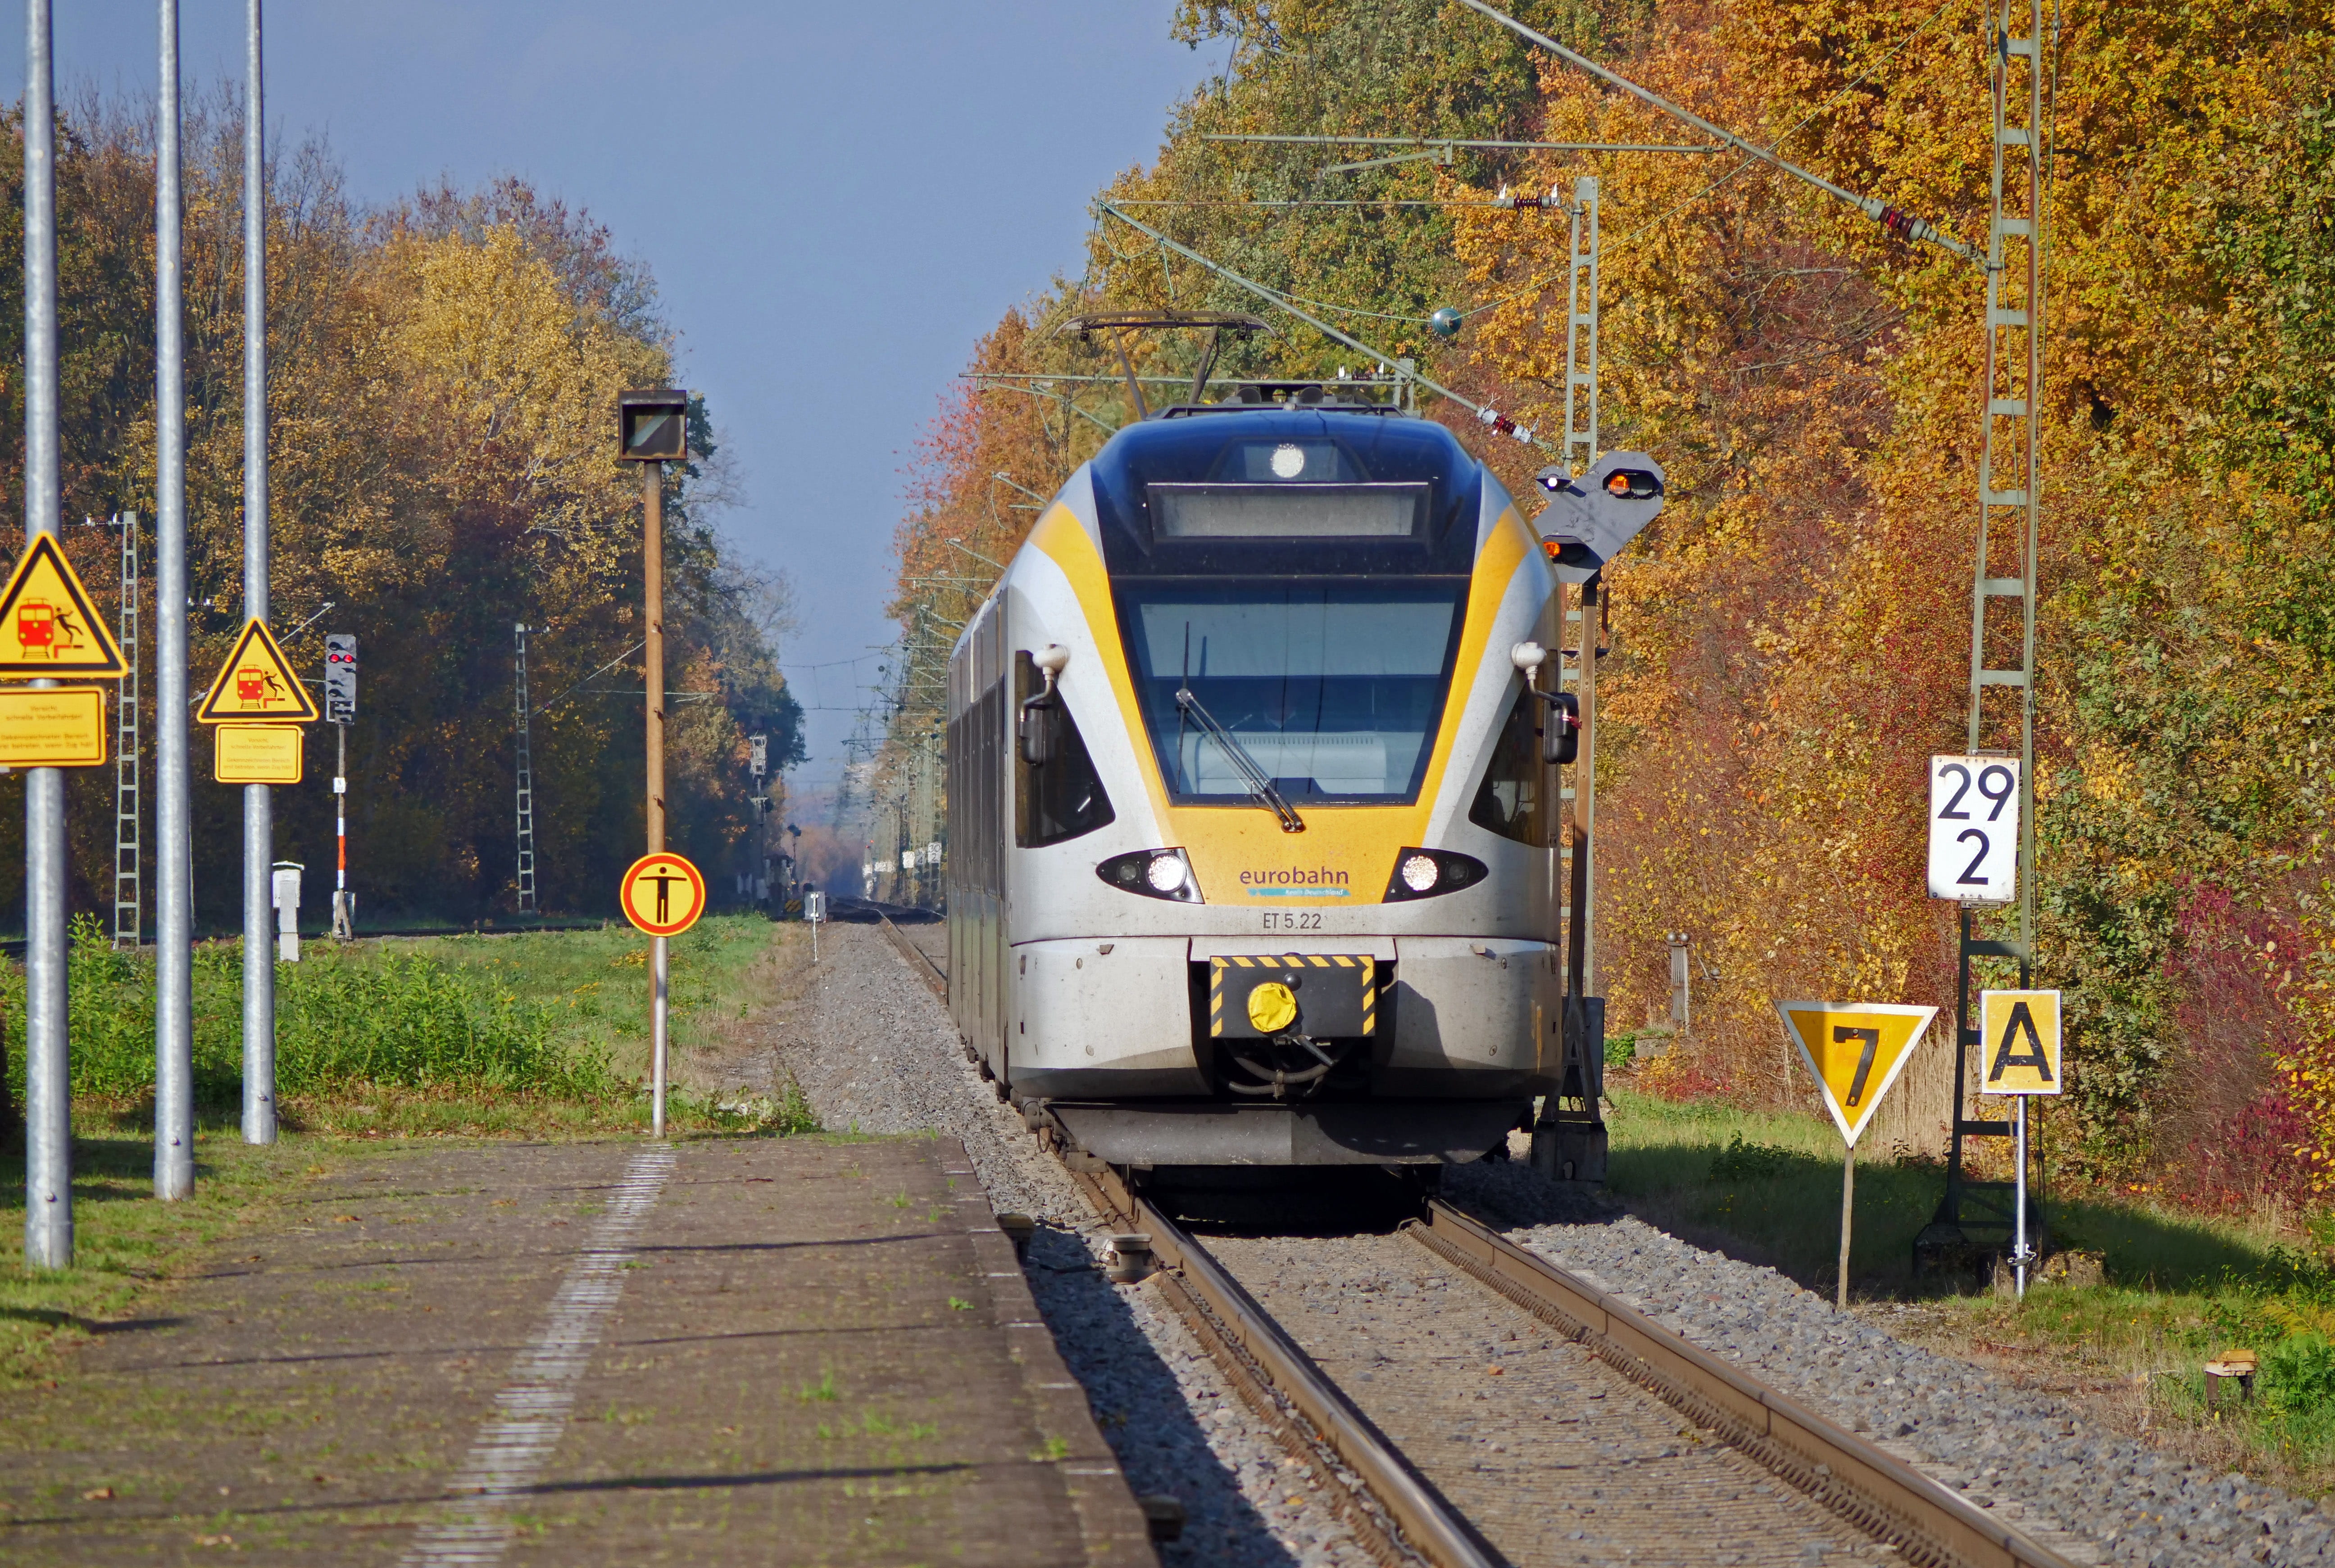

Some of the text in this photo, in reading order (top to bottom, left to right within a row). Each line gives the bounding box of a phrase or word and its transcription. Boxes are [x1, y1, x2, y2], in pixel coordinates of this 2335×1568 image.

[1938, 763, 2015, 821] 29
[1240, 866, 1349, 884] eurobahn
[1956, 828, 1990, 885] 2
[1263, 913, 1322, 929] ET 5.22
[1833, 1025, 1879, 1106] 7
[1988, 1001, 2054, 1082] A
